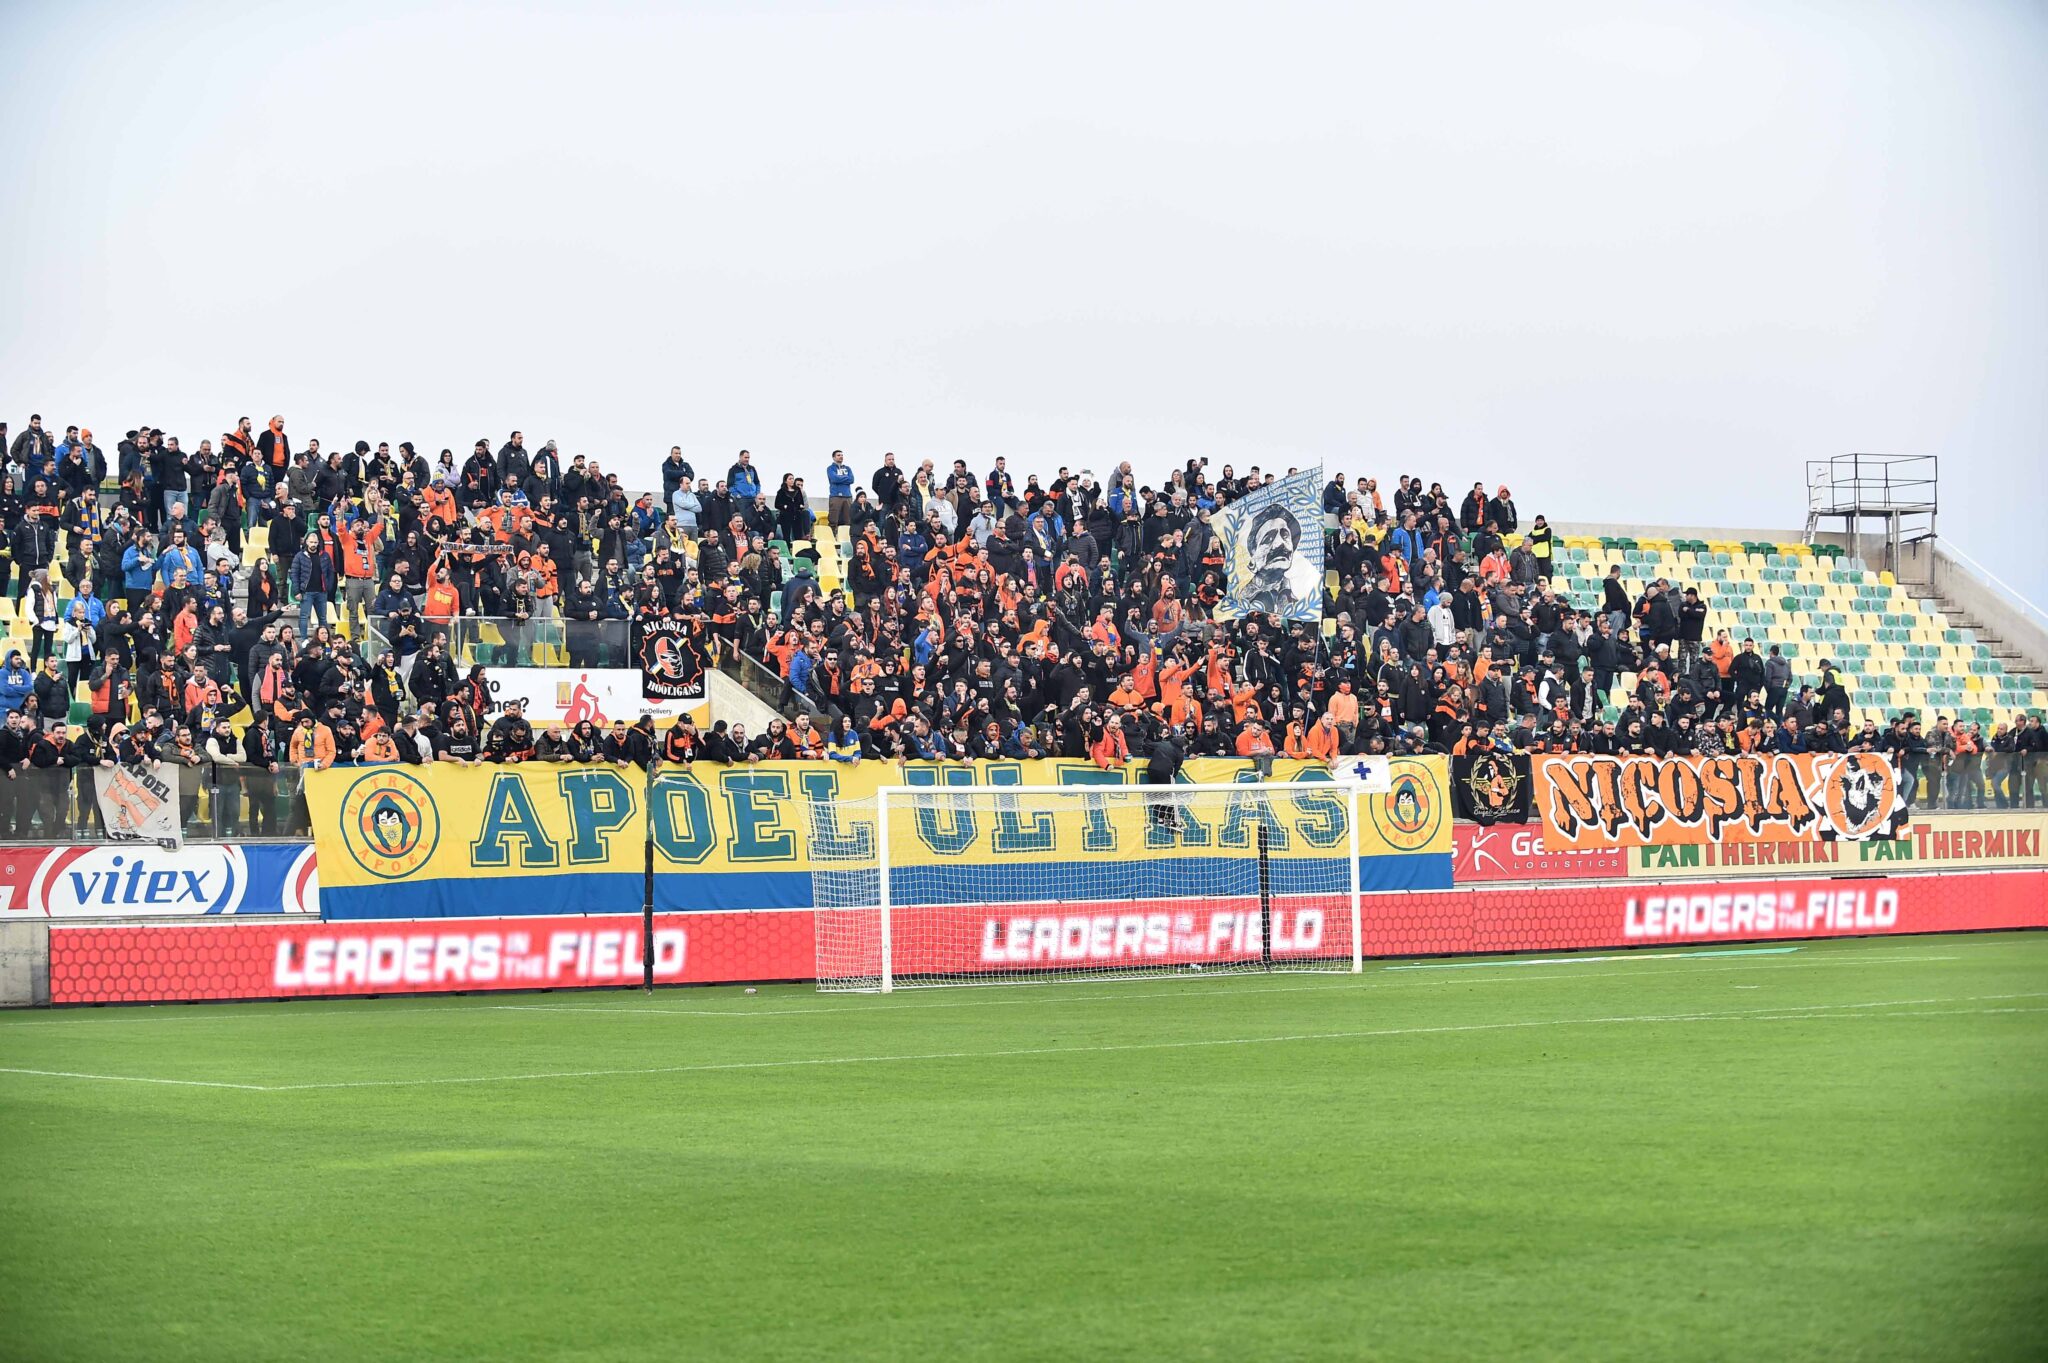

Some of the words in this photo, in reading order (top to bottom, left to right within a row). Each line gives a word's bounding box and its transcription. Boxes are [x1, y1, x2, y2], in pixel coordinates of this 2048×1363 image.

[642, 621, 688, 635] NICOSIA
[646, 680, 702, 697] HOOLIGANS
[640, 708, 672, 716] McDelivery
[121, 762, 170, 803] APOEL
[347, 775, 427, 817] ULTRAS
[1545, 756, 1815, 839] NICOSIA
[470, 770, 874, 868] APOEL
[903, 763, 1350, 856] ULTRAS
[1382, 821, 1435, 846] APOEL
[358, 840, 429, 872] APOEL
[1513, 859, 1619, 869] LOGISTICS
[1641, 841, 1839, 868] PANTHERMIKI
[1859, 824, 2040, 862] PANTHERMIKI
[68, 855, 211, 905] vitex
[1779, 891, 1797, 909] IN
[1623, 894, 1776, 938] LEADERS
[1777, 911, 1806, 929] THE
[1806, 889, 1899, 930] FIELD
[505, 932, 530, 953] IN
[546, 930, 688, 979] FIELD
[981, 916, 1171, 963] LEADERS
[1207, 909, 1324, 956] FIELD
[274, 934, 499, 987] LEADERS
[503, 954, 544, 979] THE
